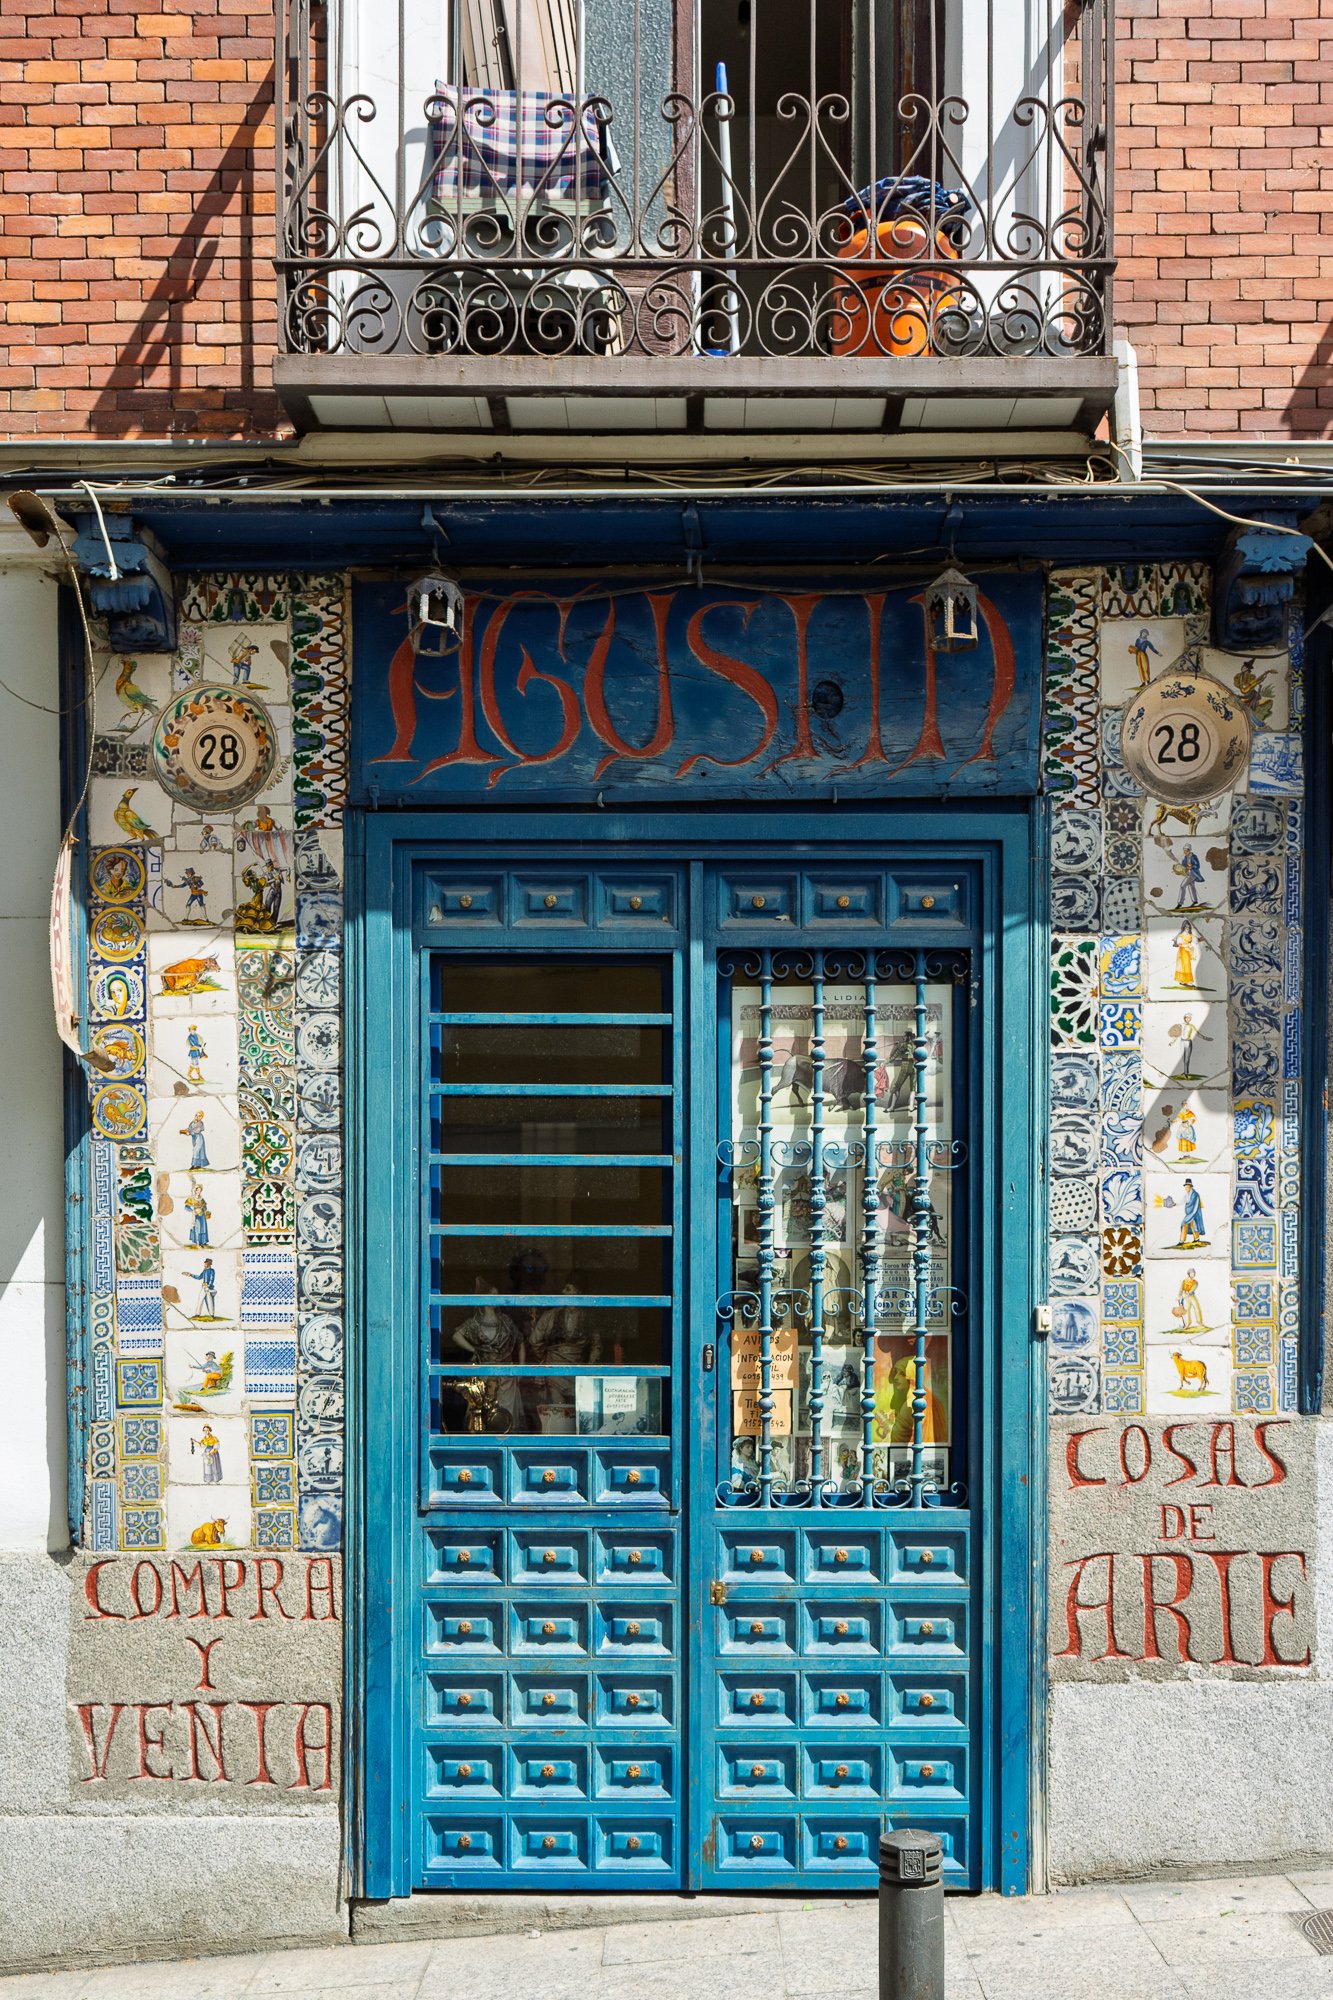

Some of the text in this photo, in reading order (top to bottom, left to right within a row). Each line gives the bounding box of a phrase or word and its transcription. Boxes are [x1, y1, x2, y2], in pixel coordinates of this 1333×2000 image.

[368, 584, 1015, 788] AGUSTIN
[199, 734, 239, 770] 28
[1155, 723, 1200, 764] 28
[743, 1335, 780, 1345] AVIOS
[1066, 1421, 1291, 1490] COSAS
[1158, 1504, 1215, 1541] DE
[81, 1558, 339, 1621] COMPRA
[1053, 1551, 1310, 1667] ARTE
[186, 1637, 223, 1690] Y
[74, 1701, 332, 1791] VENTA
